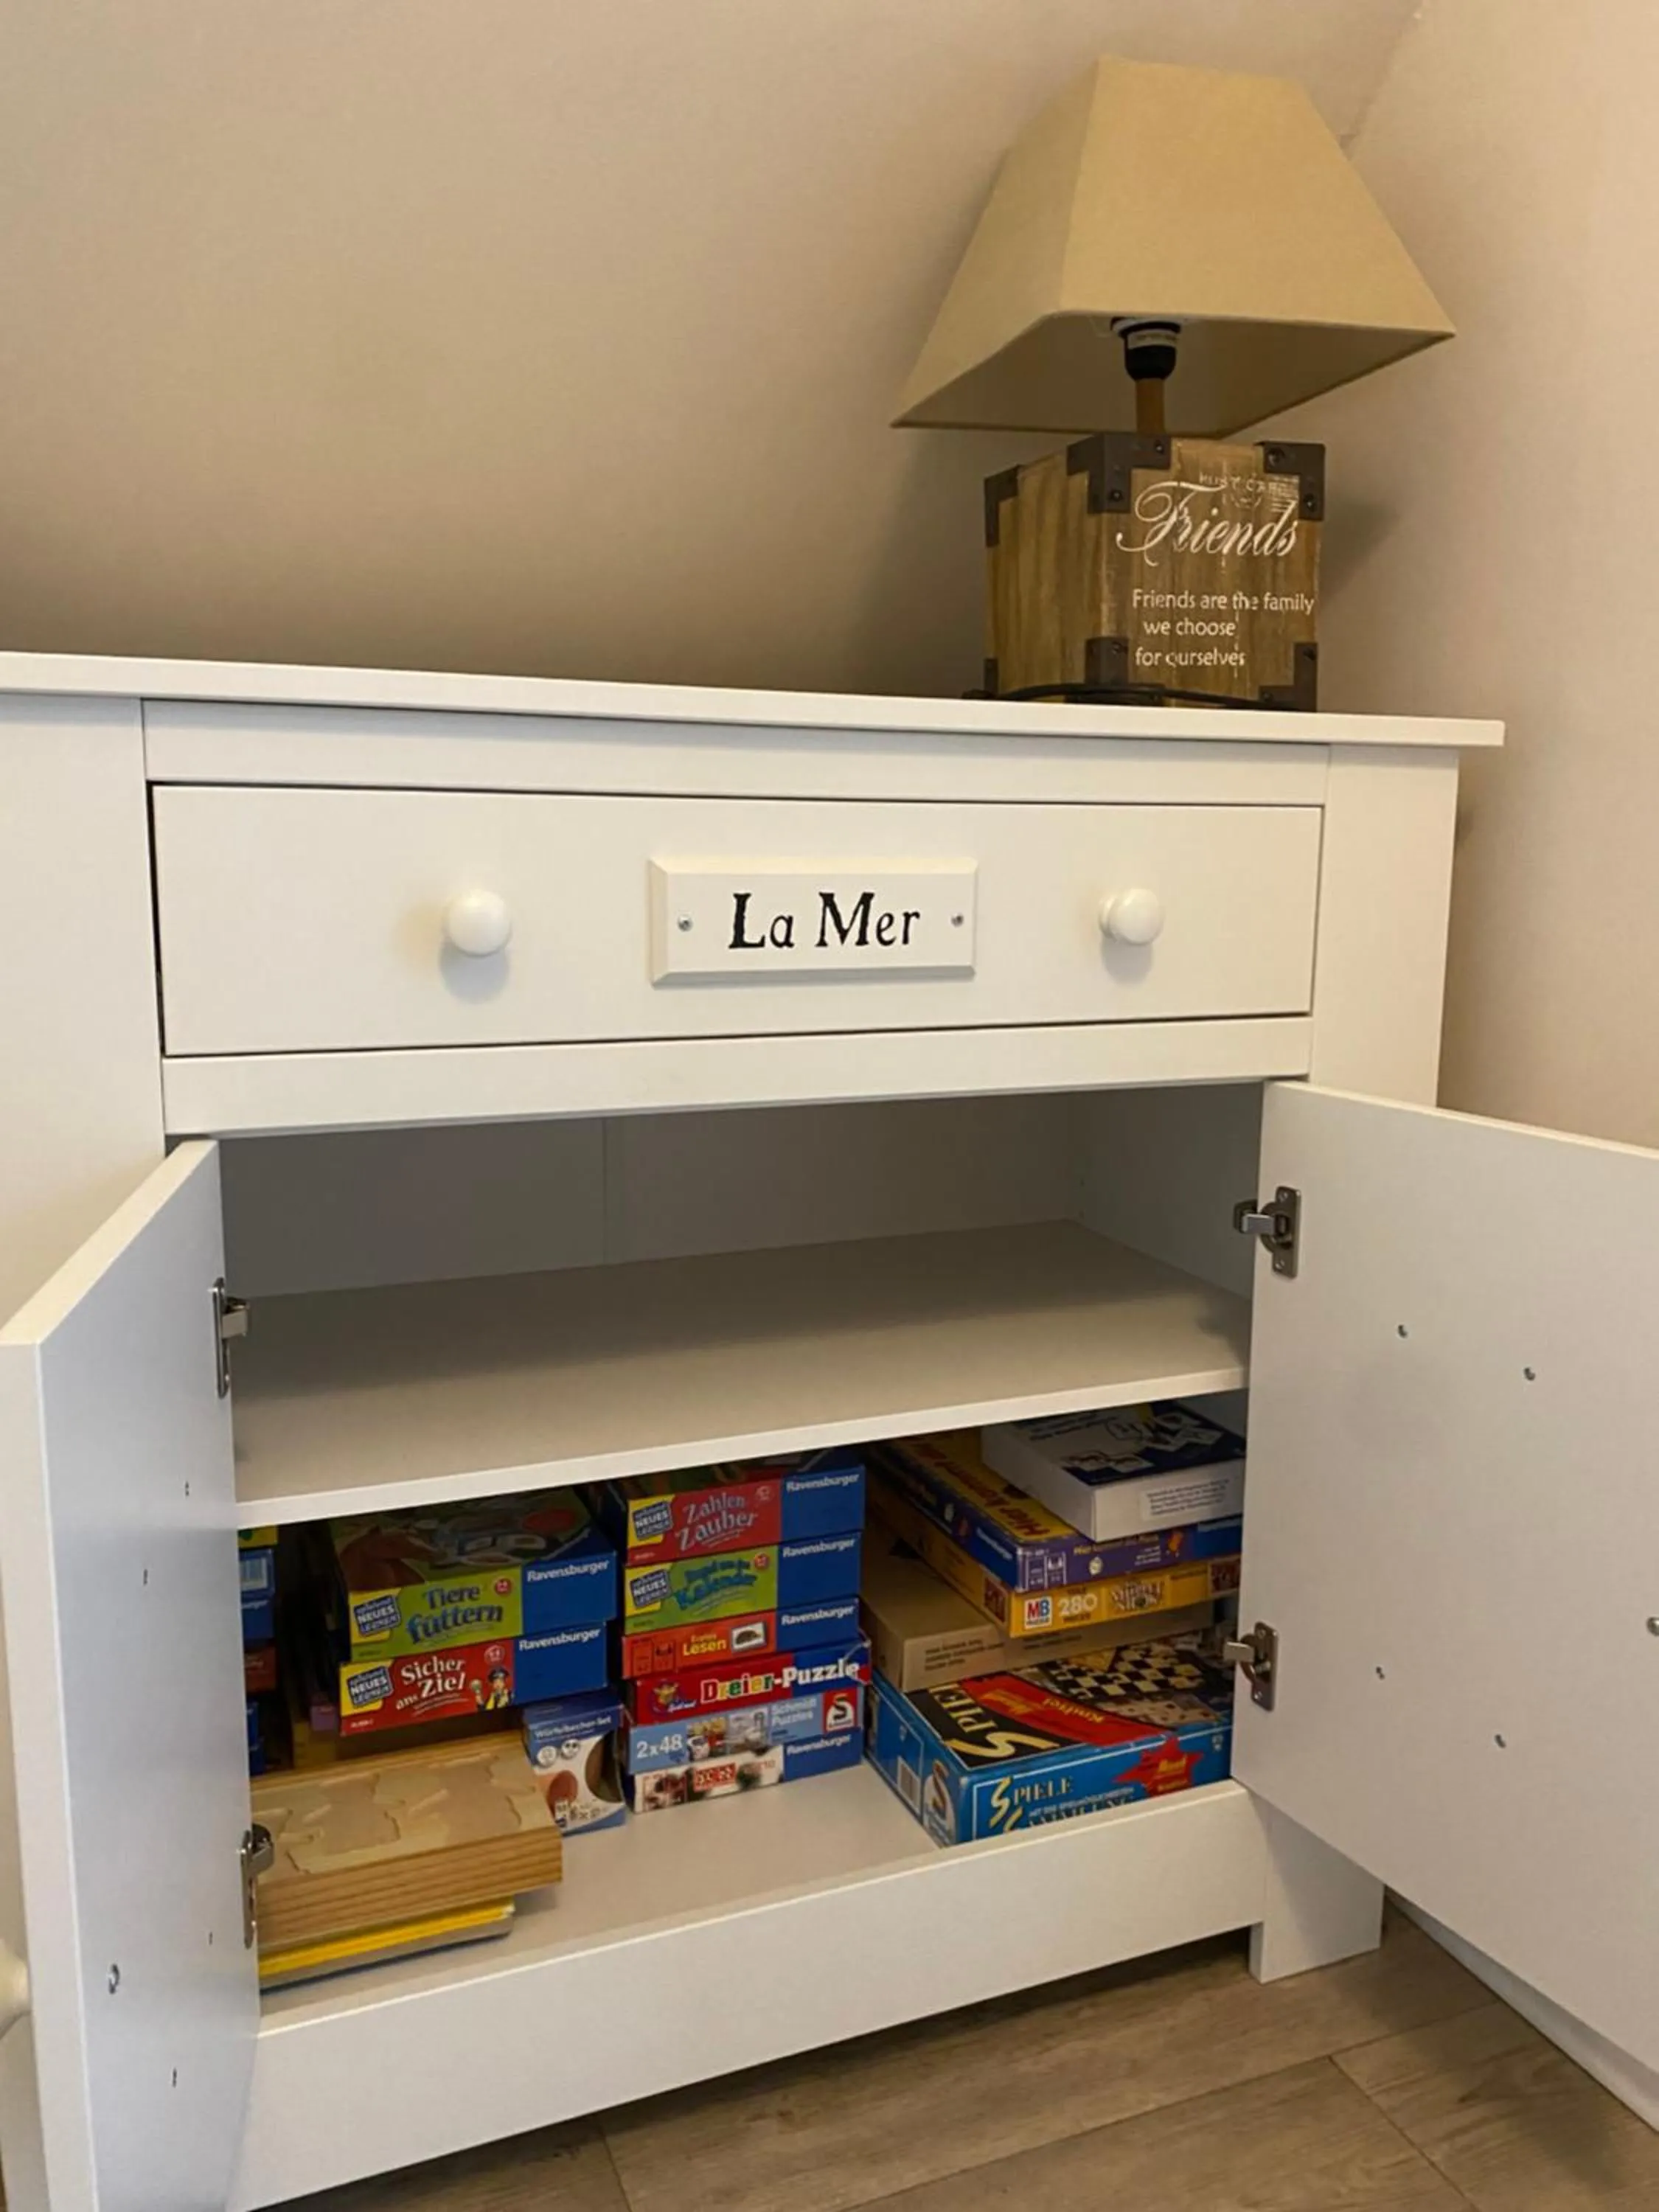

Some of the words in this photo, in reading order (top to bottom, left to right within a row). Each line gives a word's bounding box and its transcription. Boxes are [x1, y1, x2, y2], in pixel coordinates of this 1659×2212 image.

[1116, 481, 1299, 566] Friends
[1133, 590, 1195, 609] Friends
[1200, 594, 1226, 609] are
[1233, 591, 1258, 611] the
[1263, 593, 1314, 614] family
[1144, 622, 1170, 635] we
[1176, 618, 1236, 636] choose
[1136, 647, 1161, 666] for
[1166, 649, 1245, 669] ourselves
[728, 892, 794, 949] La
[815, 891, 920, 947] Mer
[786, 1473, 860, 1494] Ravensburger
[683, 1493, 745, 1524] Zahlen
[676, 1512, 758, 1551] Zauber
[782, 1539, 856, 1559] Ravensburger
[526, 1559, 609, 1582] Ravensburger
[423, 1586, 481, 1610] Tiere
[1027, 1598, 1050, 1618] MB
[1057, 1593, 1098, 1616] 280
[358, 1605, 394, 1624] NEUES
[781, 1606, 854, 1627] Ravensburger
[518, 1627, 601, 1652] Ravensburger
[683, 1639, 727, 1656] Lesen
[400, 1656, 466, 1685] Sicher
[700, 1659, 860, 1703] Dreier-Puzzle
[350, 1677, 389, 1696] NEUES
[417, 1672, 467, 1698] Ziel
[771, 1698, 817, 1714] Schmidt
[636, 1734, 683, 1759] 2x48
[786, 1733, 852, 1756] Ravensburger
[990, 1775, 1074, 1829] SPIELE
